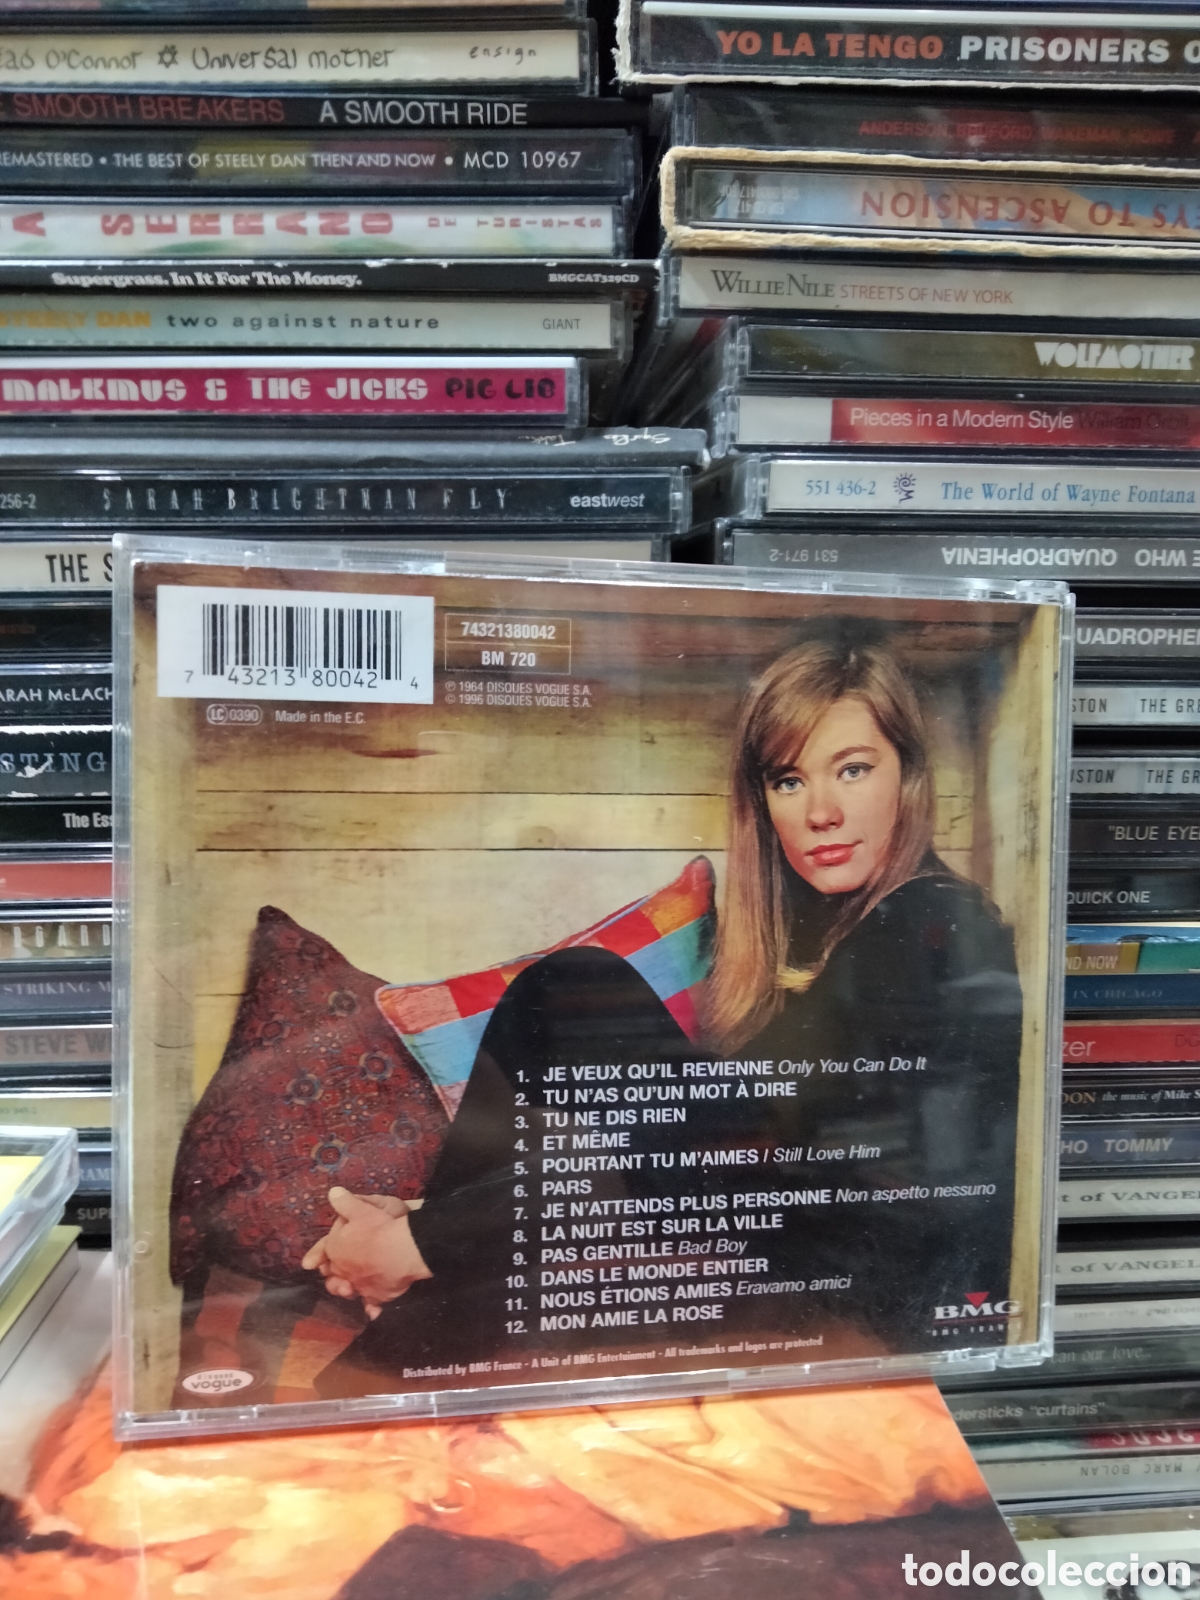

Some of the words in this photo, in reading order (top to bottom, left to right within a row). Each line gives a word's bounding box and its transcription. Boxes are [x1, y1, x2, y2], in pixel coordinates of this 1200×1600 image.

[469, 46, 537, 65] ensign
[716, 31, 761, 55] YO
[772, 32, 815, 56] LA
[826, 34, 943, 59] TENGO
[960, 36, 1170, 63] PRISONERS
[46, 49, 142, 71] O'Connor
[192, 46, 297, 70] Universal
[13, 94, 133, 120] SMOOTH
[140, 97, 284, 123] BREAKERS
[319, 100, 338, 123] A
[345, 101, 459, 124] SMOOTH
[467, 103, 528, 125] RIDE
[114, 153, 143, 167] THE
[148, 153, 183, 167] BEST
[188, 153, 209, 168] OF
[215, 153, 265, 168] STEELY
[271, 154, 306, 168] DAN
[312, 154, 352, 167] THEN
[356, 154, 391, 168] AND
[395, 154, 435, 167] NOW
[463, 151, 509, 168] MCD
[520, 151, 582, 169] 10967
[860, 190, 1071, 225] ASCENSION
[101, 212, 393, 236] SERRANO
[477, 217, 603, 228] TURISTAS
[51, 272, 169, 288] Supergrass.
[217, 272, 250, 286] For
[252, 271, 291, 286] The
[293, 272, 362, 288] Money.
[711, 269, 784, 294] WILLIE
[786, 273, 835, 297] NILE
[840, 284, 905, 300] STREETS
[908, 287, 929, 301] OF
[932, 288, 968, 303] NEW
[975, 290, 1013, 304] YORK
[167, 315, 218, 327] two
[232, 315, 337, 330] against
[350, 316, 439, 329] nature
[542, 318, 581, 330] GIANT
[1034, 341, 1195, 371] WOLFMOTHER
[2, 378, 187, 402] MALKMUS
[247, 377, 311, 400] THE
[325, 377, 429, 400] JICKS
[445, 378, 497, 399] PIG
[505, 378, 556, 399] LIB
[850, 407, 912, 427] Pieces
[917, 409, 931, 426] in
[937, 413, 948, 427] a
[952, 410, 1023, 428] Modern
[1028, 410, 1074, 433] Style
[103, 486, 203, 511] SARAH
[443, 487, 511, 511] FLY
[570, 490, 646, 508] eastwest
[805, 480, 830, 496] 551
[836, 480, 876, 496] 436-2
[941, 482, 973, 500] The
[981, 482, 1034, 501] World
[1041, 482, 1061, 500] of
[1066, 484, 1121, 507] Wayne
[1127, 485, 1195, 504] Fontana
[769, 548, 809, 562] 971-2
[814, 549, 838, 562] 531
[941, 546, 1117, 567] QUADROPHENIA
[1134, 549, 1187, 567] WHO
[46, 553, 90, 584] THE
[460, 621, 556, 640] 74321380042
[481, 651, 504, 666] BM
[510, 652, 536, 667] 720
[227, 667, 296, 686] 43213
[312, 669, 378, 689] 80042
[459, 681, 484, 693] 1964
[487, 682, 533, 695] DISQUES
[536, 684, 570, 696] VOGUE
[487, 695, 533, 707] DISQUES
[536, 696, 570, 708] VOGUE
[1140, 698, 1168, 713] THE
[275, 709, 306, 722] Made
[324, 711, 343, 724] the
[0, 752, 107, 774] STING
[1146, 769, 1175, 784] THE
[62, 812, 90, 828] The
[1108, 825, 1159, 841] "BLUE
[1116, 890, 1151, 904] ONE
[1086, 955, 1119, 970] NOW
[5, 1034, 78, 1056] STEVE
[572, 1065, 622, 1080] VEUX
[627, 1063, 677, 1079] QU'IL
[682, 1061, 774, 1077] REVIENNE
[778, 1060, 815, 1077] Only
[820, 1059, 848, 1073] You
[853, 1057, 884, 1072] Can
[574, 1087, 618, 1103] N'AS
[623, 1085, 684, 1102] QU'UN
[690, 1083, 731, 1099] MOT
[754, 1082, 798, 1097] DIRE
[1102, 1091, 1117, 1101] the
[1120, 1091, 1148, 1101] music
[1164, 1089, 1192, 1100] Mike
[606, 1110, 637, 1125] DIS
[643, 1107, 686, 1123] RIEN
[572, 1130, 630, 1149] MÊME
[1104, 1138, 1174, 1153] TOMMY
[542, 1154, 645, 1173] POURTANT
[680, 1149, 758, 1167] M'AIMES
[773, 1147, 802, 1163] Still
[807, 1147, 844, 1161] Love
[849, 1144, 881, 1159] Him
[542, 1179, 592, 1196] PARS
[570, 1197, 675, 1217] N'ATTENDS
[680, 1195, 728, 1211] PLUS
[733, 1189, 832, 1209] PERSONNE
[835, 1188, 868, 1203] Non
[872, 1184, 930, 1202] aspetto
[934, 1183, 997, 1198] nessuno
[571, 1222, 616, 1239] NUIT
[621, 1220, 656, 1237] EST
[661, 1218, 700, 1234] SUR
[733, 1213, 784, 1230] VILLE
[541, 1247, 578, 1264] PAS
[582, 1241, 674, 1261] GENTILLE
[677, 1239, 712, 1256] Bad
[715, 1238, 748, 1255] Boy
[541, 1268, 594, 1287] DANS
[628, 1262, 698, 1280] MONDE
[703, 1257, 769, 1276] ENTIER
[1071, 1262, 1096, 1273] of
[540, 1291, 596, 1309] NOUS
[601, 1285, 670, 1305] ÉTIONS
[674, 1282, 732, 1299] AMIES
[735, 1280, 805, 1297] Eravamo
[809, 1274, 852, 1291] amici
[540, 1314, 586, 1332] MON
[591, 1310, 639, 1327] AMIE
[672, 1304, 724, 1322] ROSE
[934, 1300, 1020, 1320] BMG
[403, 1364, 453, 1379] Distributed
[469, 1362, 492, 1374] BMG
[494, 1361, 522, 1372] France
[541, 1356, 559, 1368] Unit
[574, 1353, 595, 1365] BMG
[597, 1350, 655, 1364] Entertainment
[679, 1344, 726, 1357] trademarks
[728, 1341, 743, 1353] and
[745, 1341, 767, 1354] logos
[769, 1340, 783, 1350] are
[784, 1335, 823, 1351] protected
[191, 1378, 242, 1392] vogue
[1081, 1463, 1131, 1476] BOLAN
[1144, 1462, 1183, 1474] MARC
